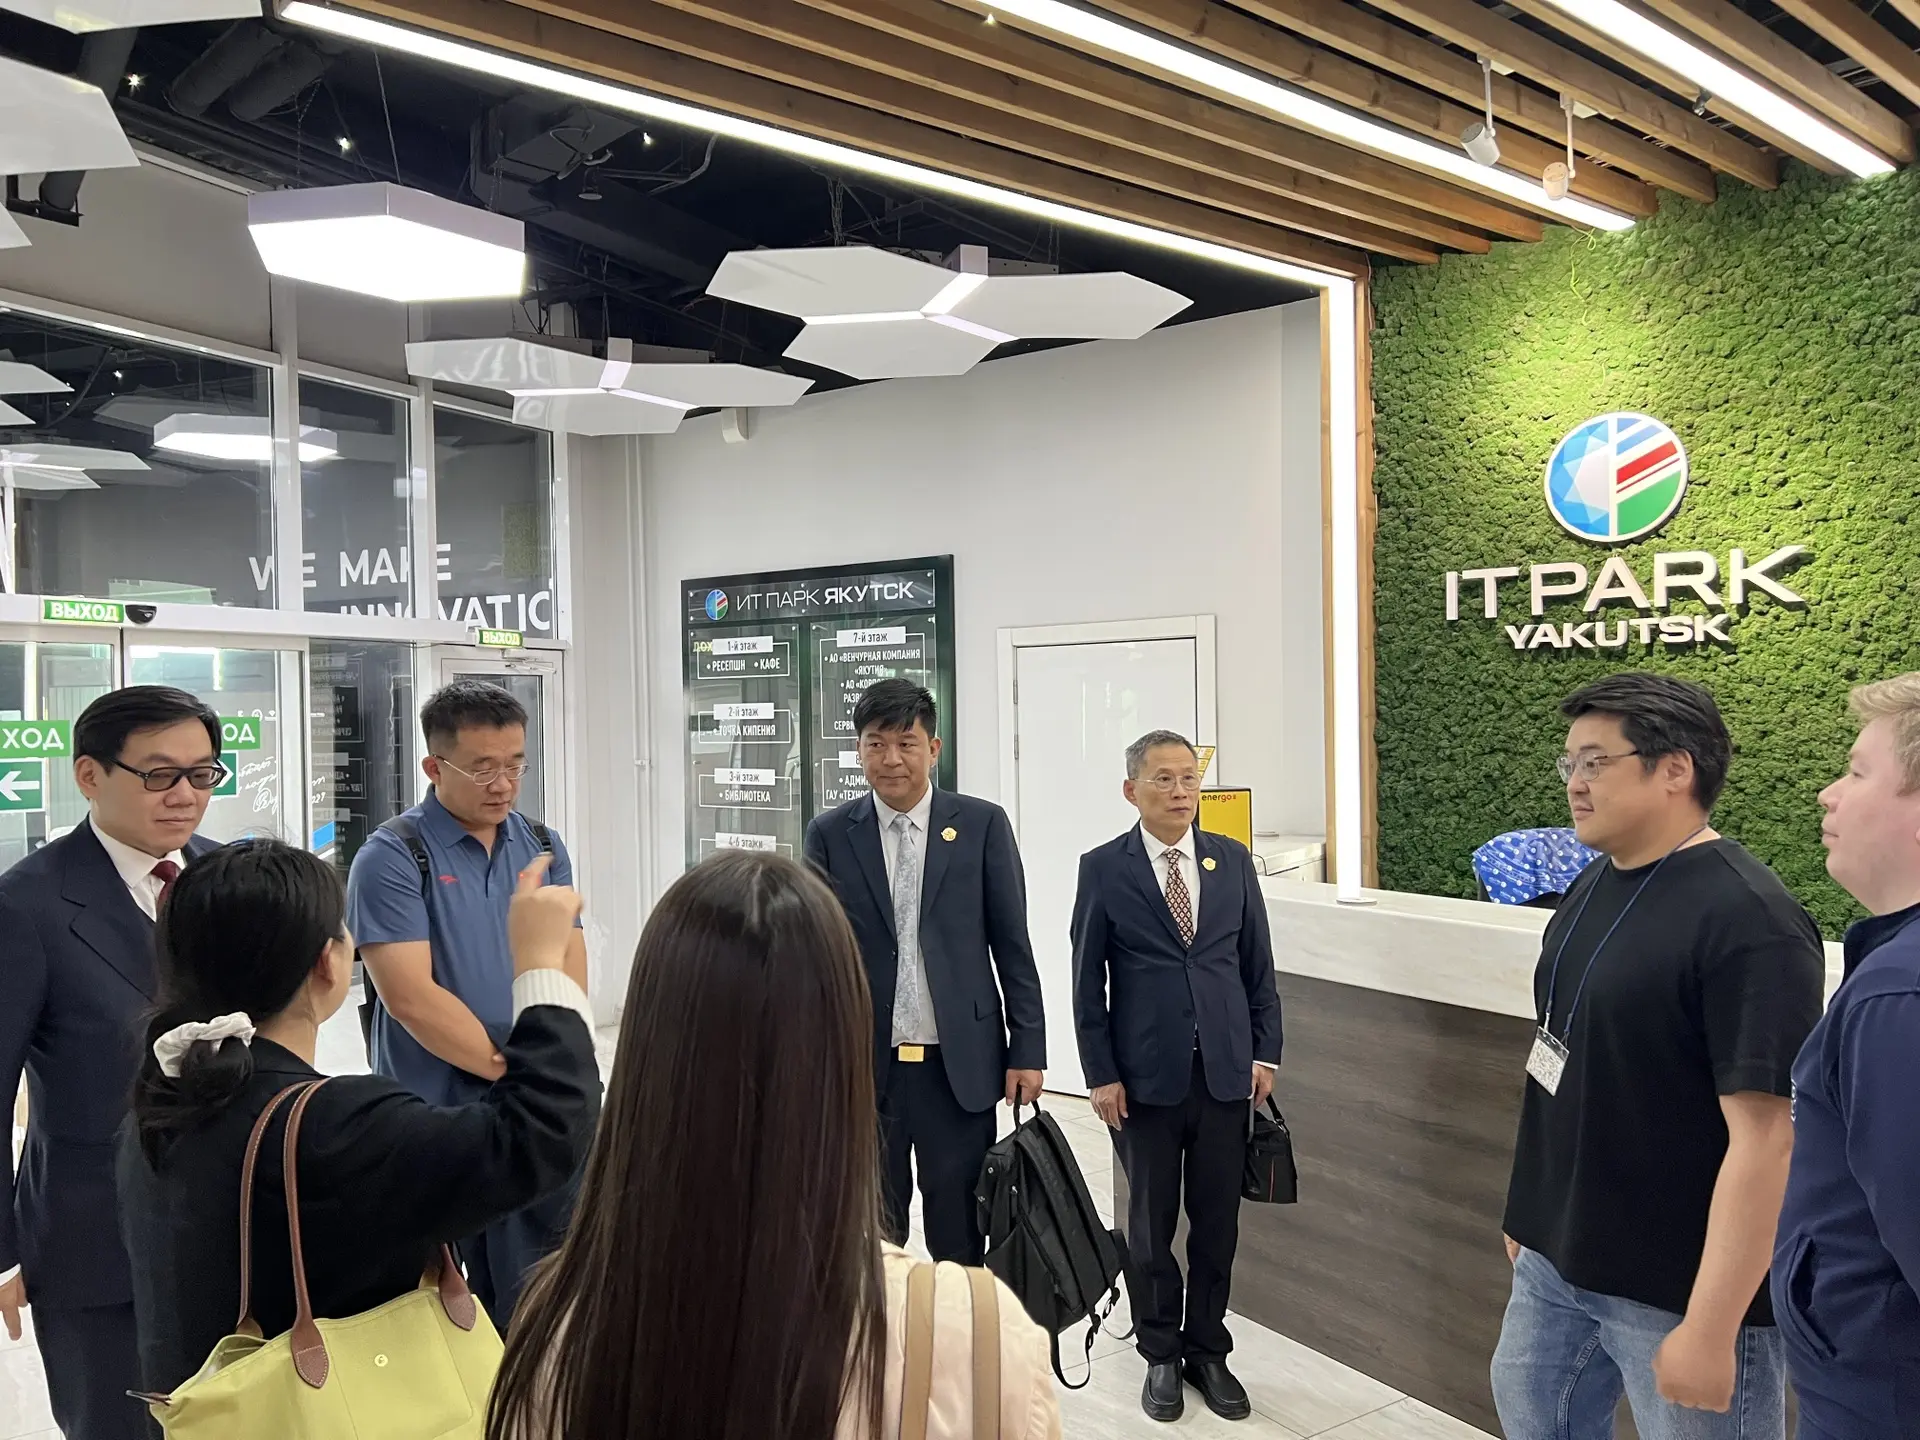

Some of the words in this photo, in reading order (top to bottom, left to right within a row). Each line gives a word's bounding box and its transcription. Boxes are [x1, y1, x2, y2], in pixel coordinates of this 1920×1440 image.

[1445, 566, 1520, 621] IT
[1531, 544, 1806, 616] PARK
[736, 594, 762, 611] ИТ
[767, 588, 819, 608] ПАРК
[825, 581, 914, 605] ЯКУТСК
[51, 601, 119, 621] ВЫХОД
[854, 632, 865, 643] 7-й
[868, 632, 888, 643] этаж
[1505, 613, 1730, 650] YAKUTSK
[483, 631, 520, 646] ВЫХОД
[728, 641, 738, 652] 1-й
[740, 642, 757, 651] этаж
[829, 653, 838, 663] АО
[840, 651, 881, 663] «ВЕНЧУРНАЯ
[883, 649, 921, 661] КОМПАНИЯ
[712, 660, 746, 672] РЕСЕПШН
[760, 658, 780, 670] КАФЕ
[846, 680, 855, 690] АО
[843, 693, 862, 703] РАЗВ
[741, 708, 759, 717] этаж
[719, 725, 741, 736] ТОЧКА
[743, 724, 776, 736] КИПЕНИЯ
[2, 728, 64, 751] ХОД
[742, 774, 760, 782] этаж
[725, 789, 771, 802] БИБЛИОТЕКА
[826, 789, 838, 800] ГАУ
[1201, 794, 1232, 803] energo
